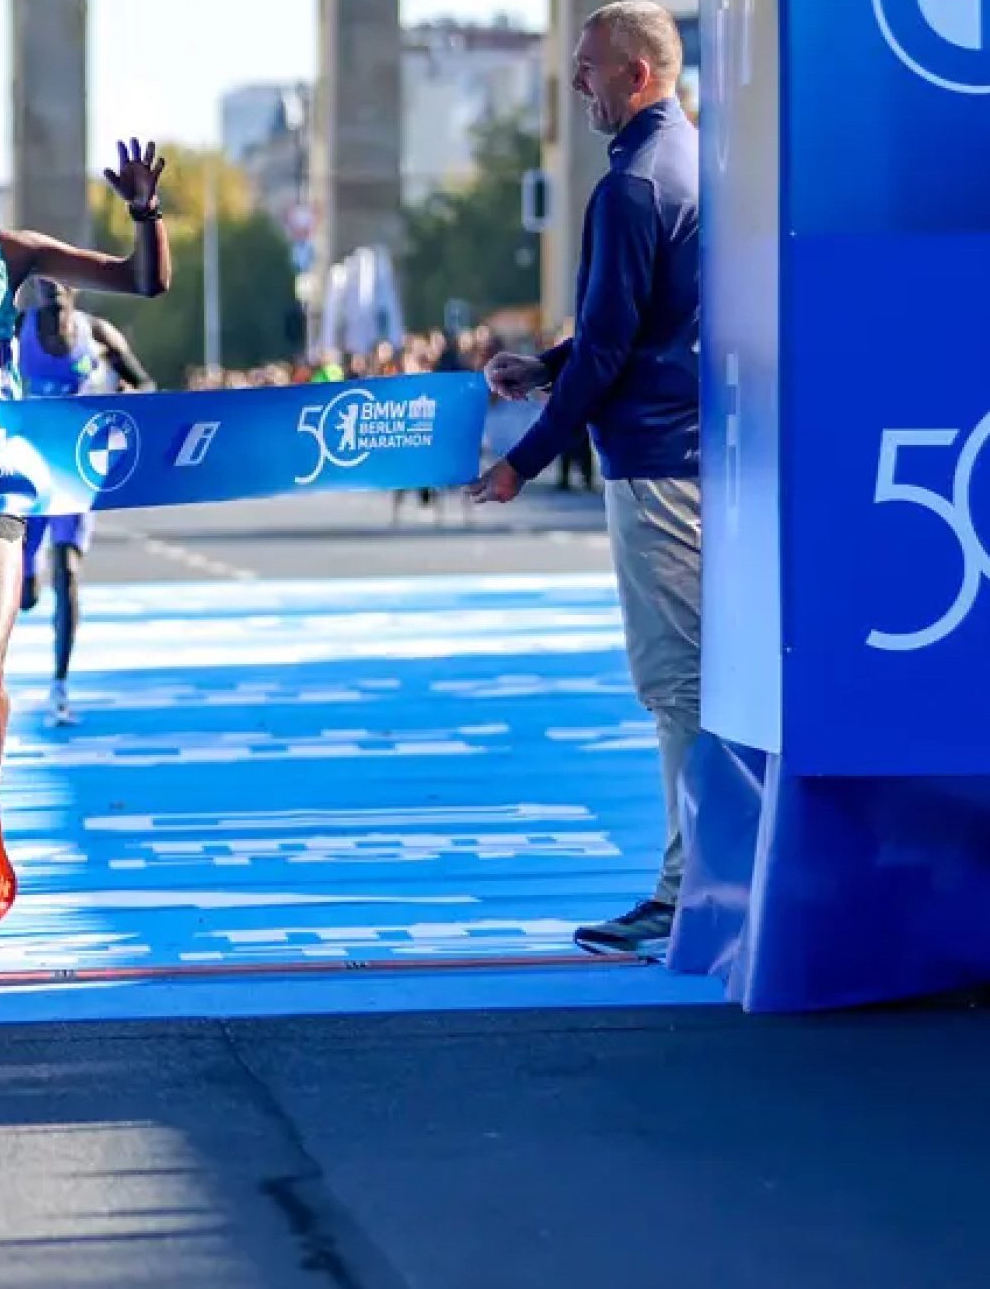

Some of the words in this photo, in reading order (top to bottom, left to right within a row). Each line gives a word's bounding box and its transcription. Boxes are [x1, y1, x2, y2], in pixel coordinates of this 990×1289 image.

[362, 400, 407, 420] BMW
[360, 421, 405, 434] BERLIN
[358, 435, 432, 450] MARATHON
